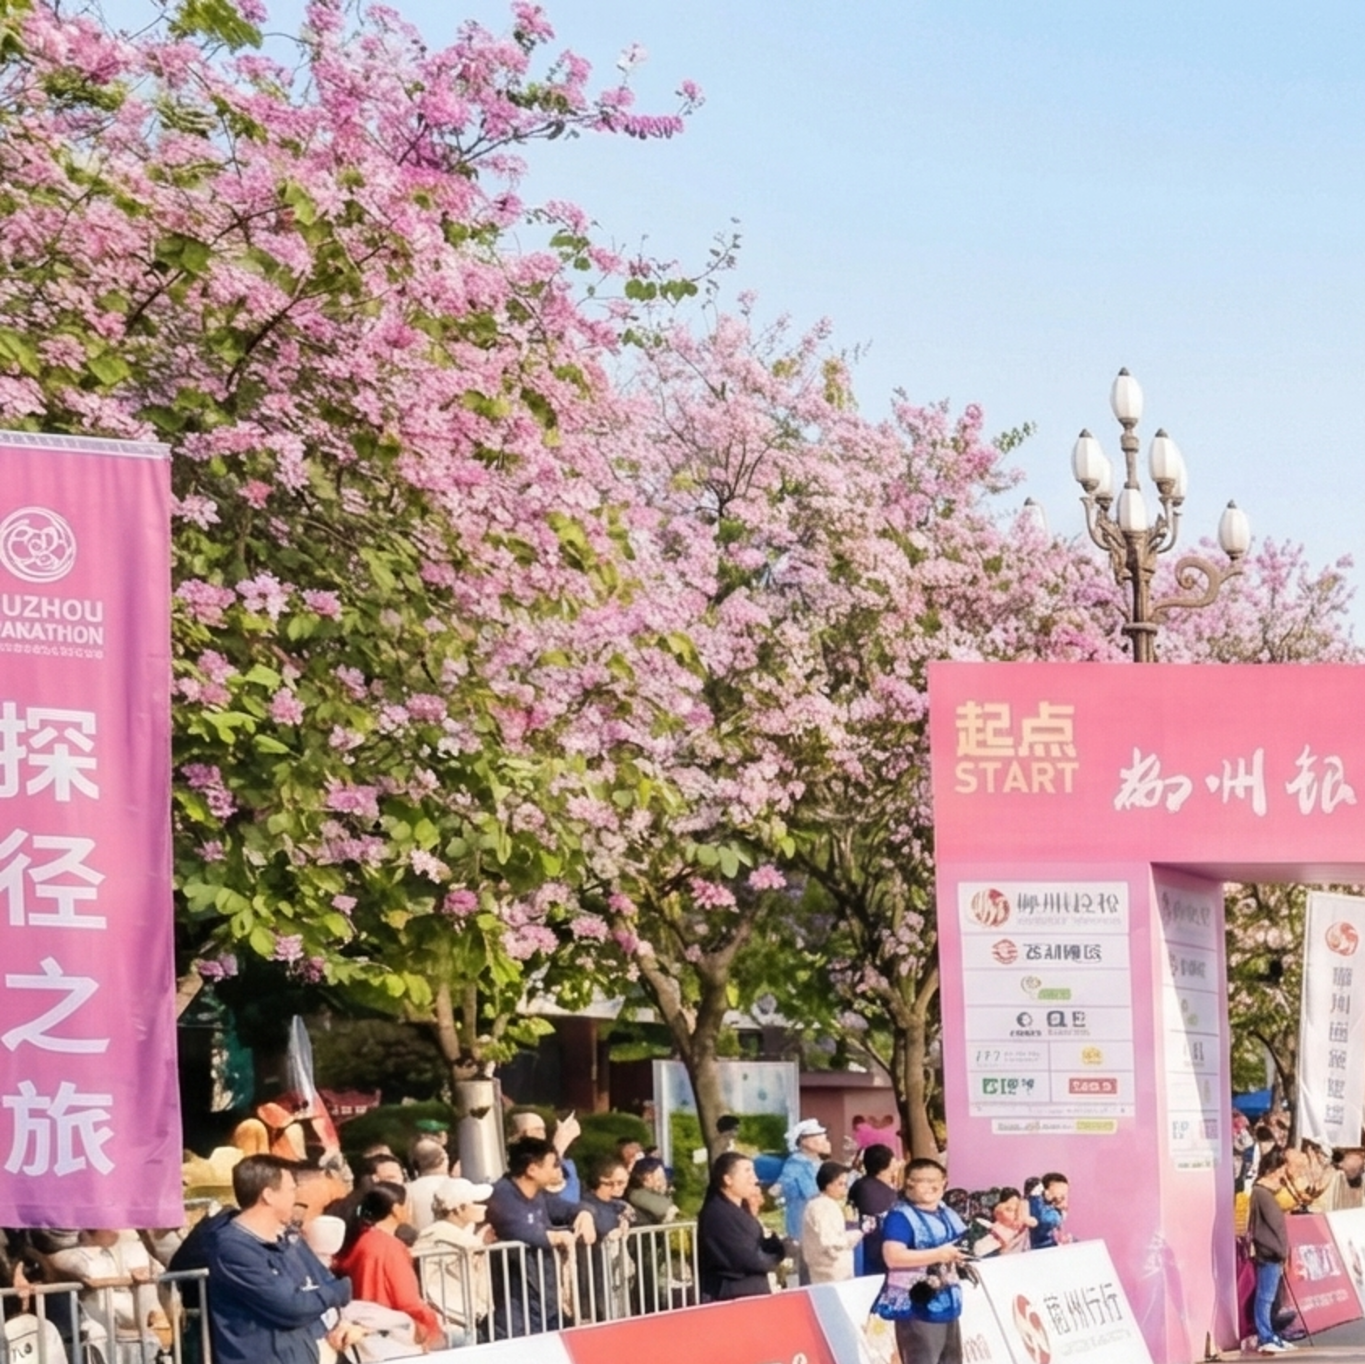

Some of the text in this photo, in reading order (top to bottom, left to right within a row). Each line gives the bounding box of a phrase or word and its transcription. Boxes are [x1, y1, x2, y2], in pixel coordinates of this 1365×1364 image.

[956, 701, 1078, 758] 起点
[954, 761, 1079, 794] START
[0, 701, 116, 1177] 探径之旅
